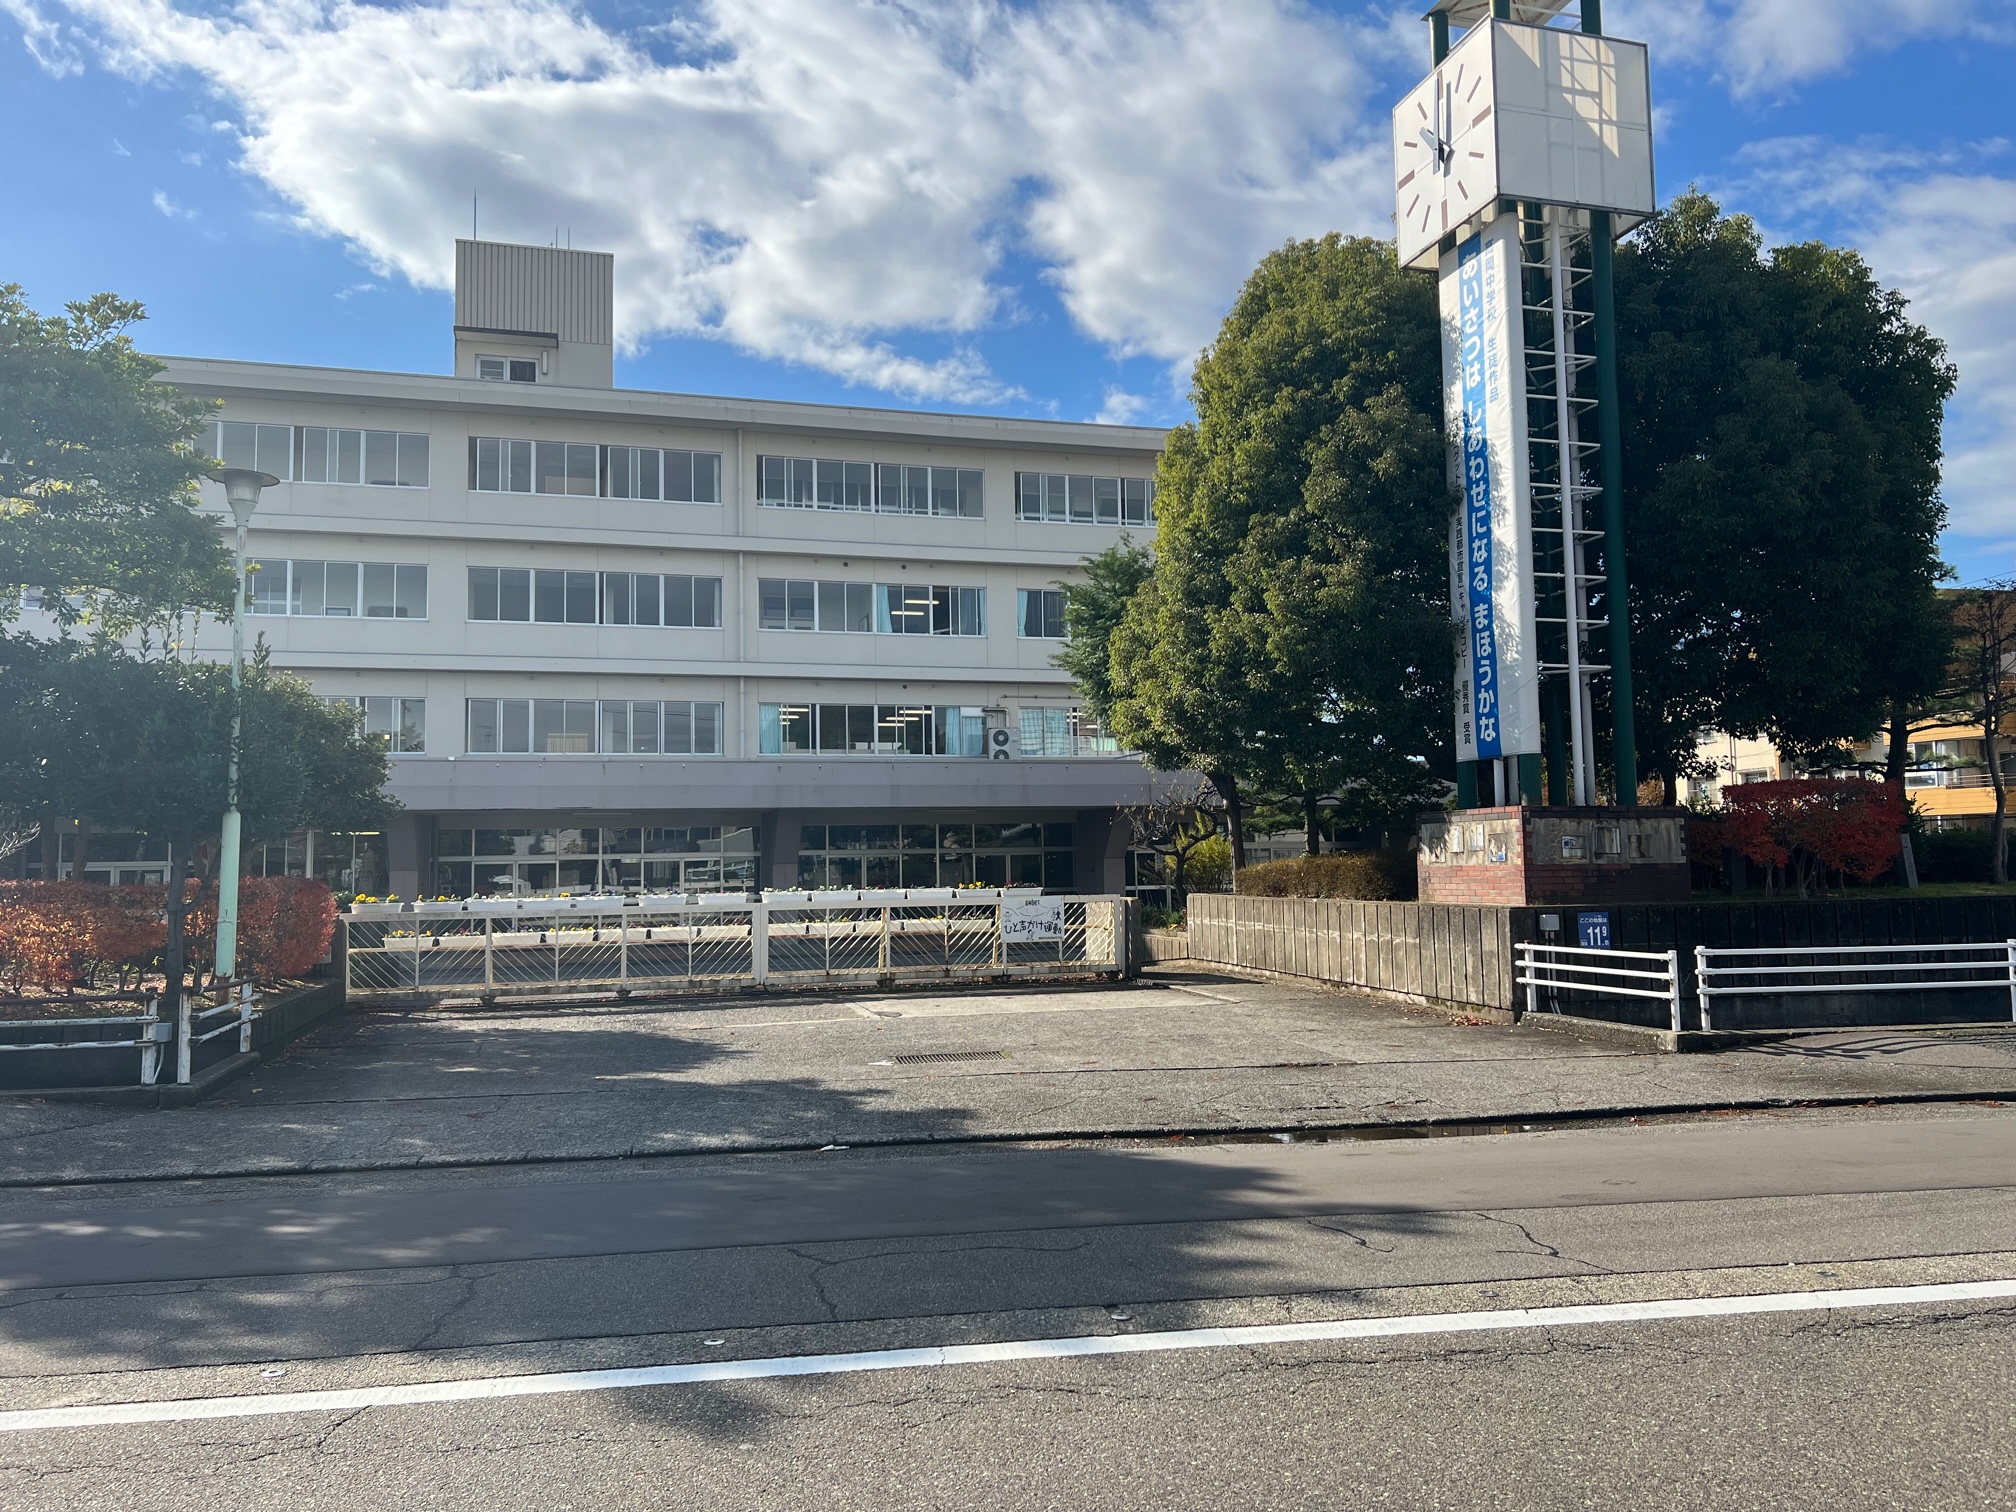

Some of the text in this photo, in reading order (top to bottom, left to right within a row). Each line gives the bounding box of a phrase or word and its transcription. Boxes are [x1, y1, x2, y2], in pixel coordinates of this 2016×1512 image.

[1486, 337, 1500, 404] 生徒作品
[1462, 252, 1497, 742] あいさつは しあわせになる まほうかな
[1461, 679, 1471, 714] 優秀賞
[1463, 722, 1472, 745] 受賞
[1004, 920, 1062, 934] ひと声かけ運動
